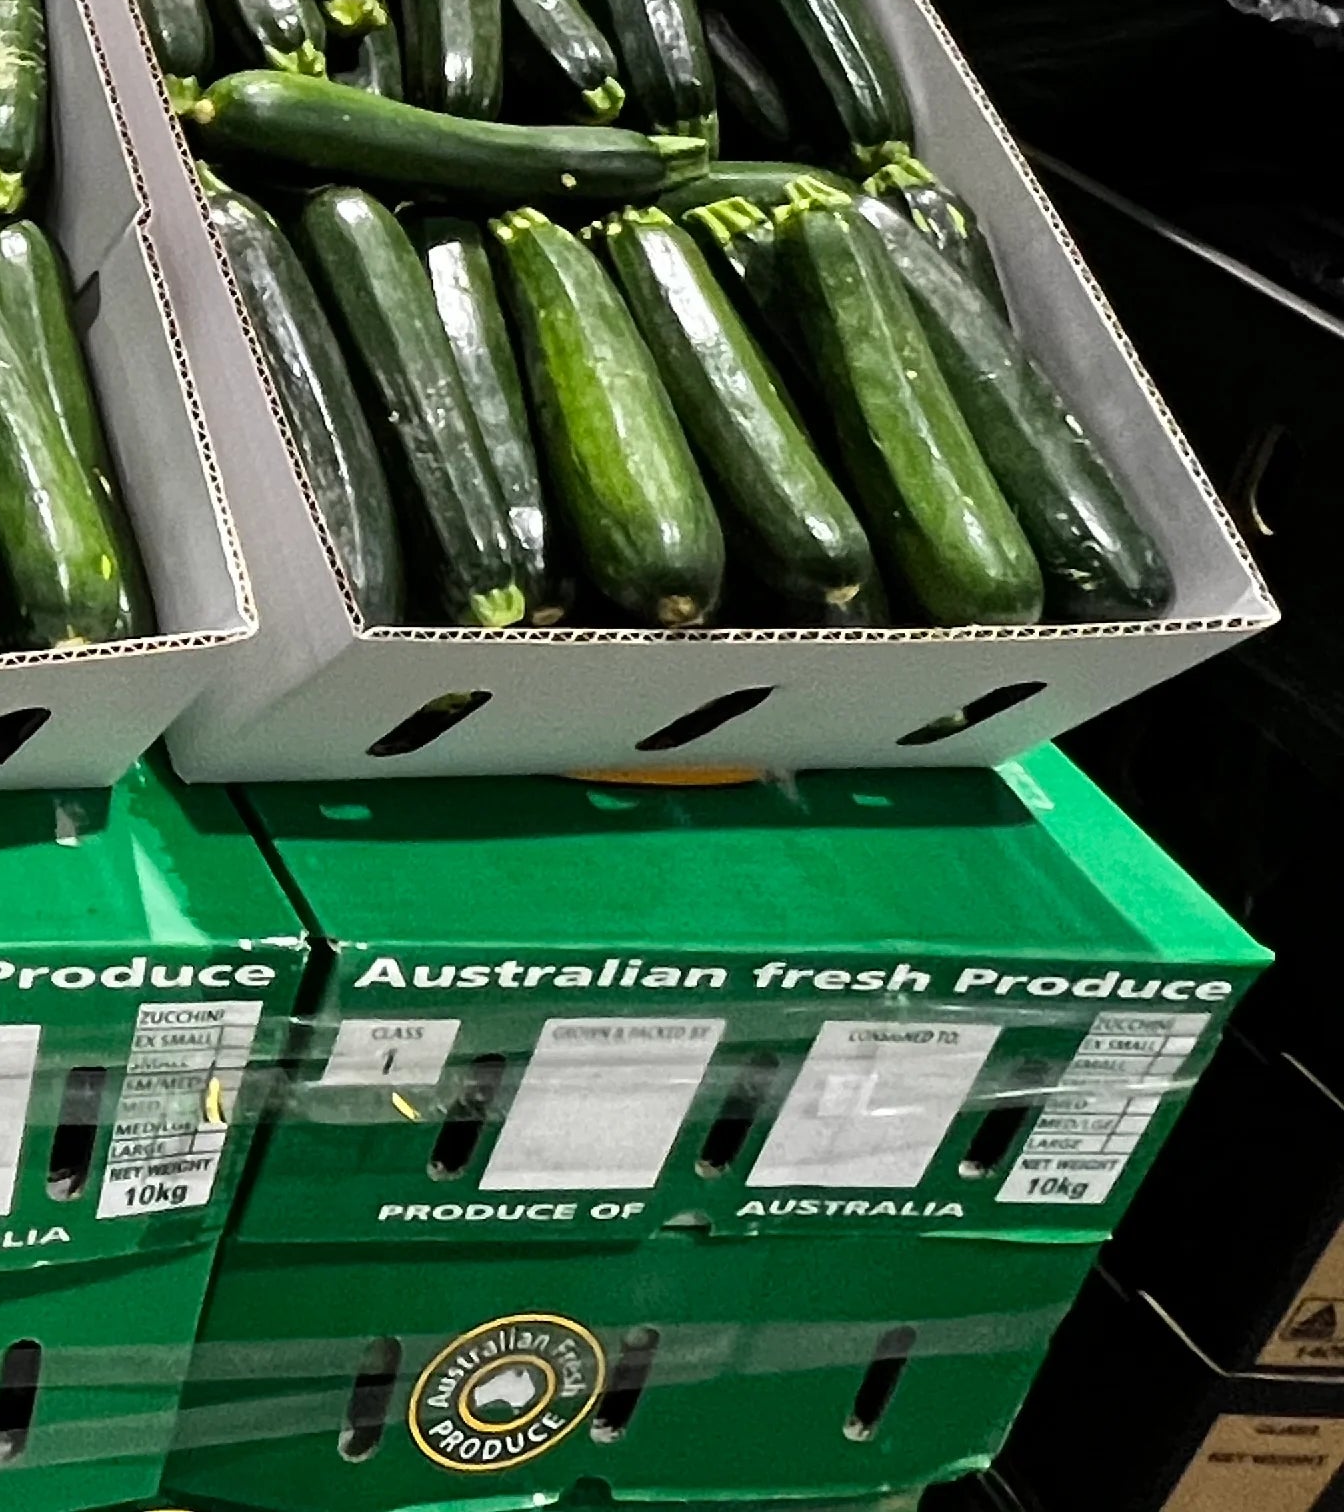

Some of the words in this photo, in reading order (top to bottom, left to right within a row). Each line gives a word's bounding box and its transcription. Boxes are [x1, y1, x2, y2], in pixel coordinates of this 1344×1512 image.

[354, 956, 728, 989] Australian
[753, 961, 931, 993] fresh
[953, 967, 1233, 1002] Produce
[135, 1034, 156, 1048] EX
[161, 1033, 212, 1046] SMALL
[371, 1026, 425, 1040] CLASS
[110, 1165, 144, 1181] NET
[147, 1158, 211, 1176] WEIGHT
[124, 1183, 188, 1207] 10kg
[1027, 1175, 1090, 1200] 10kg
[378, 1203, 577, 1221] PRODUCE
[589, 1202, 645, 1220] OF
[736, 1199, 965, 1219] AUSTRALIA
[427, 1327, 551, 1410] Australian
[551, 1336, 587, 1399] Fresh
[427, 1410, 566, 1463] PRODUCE
